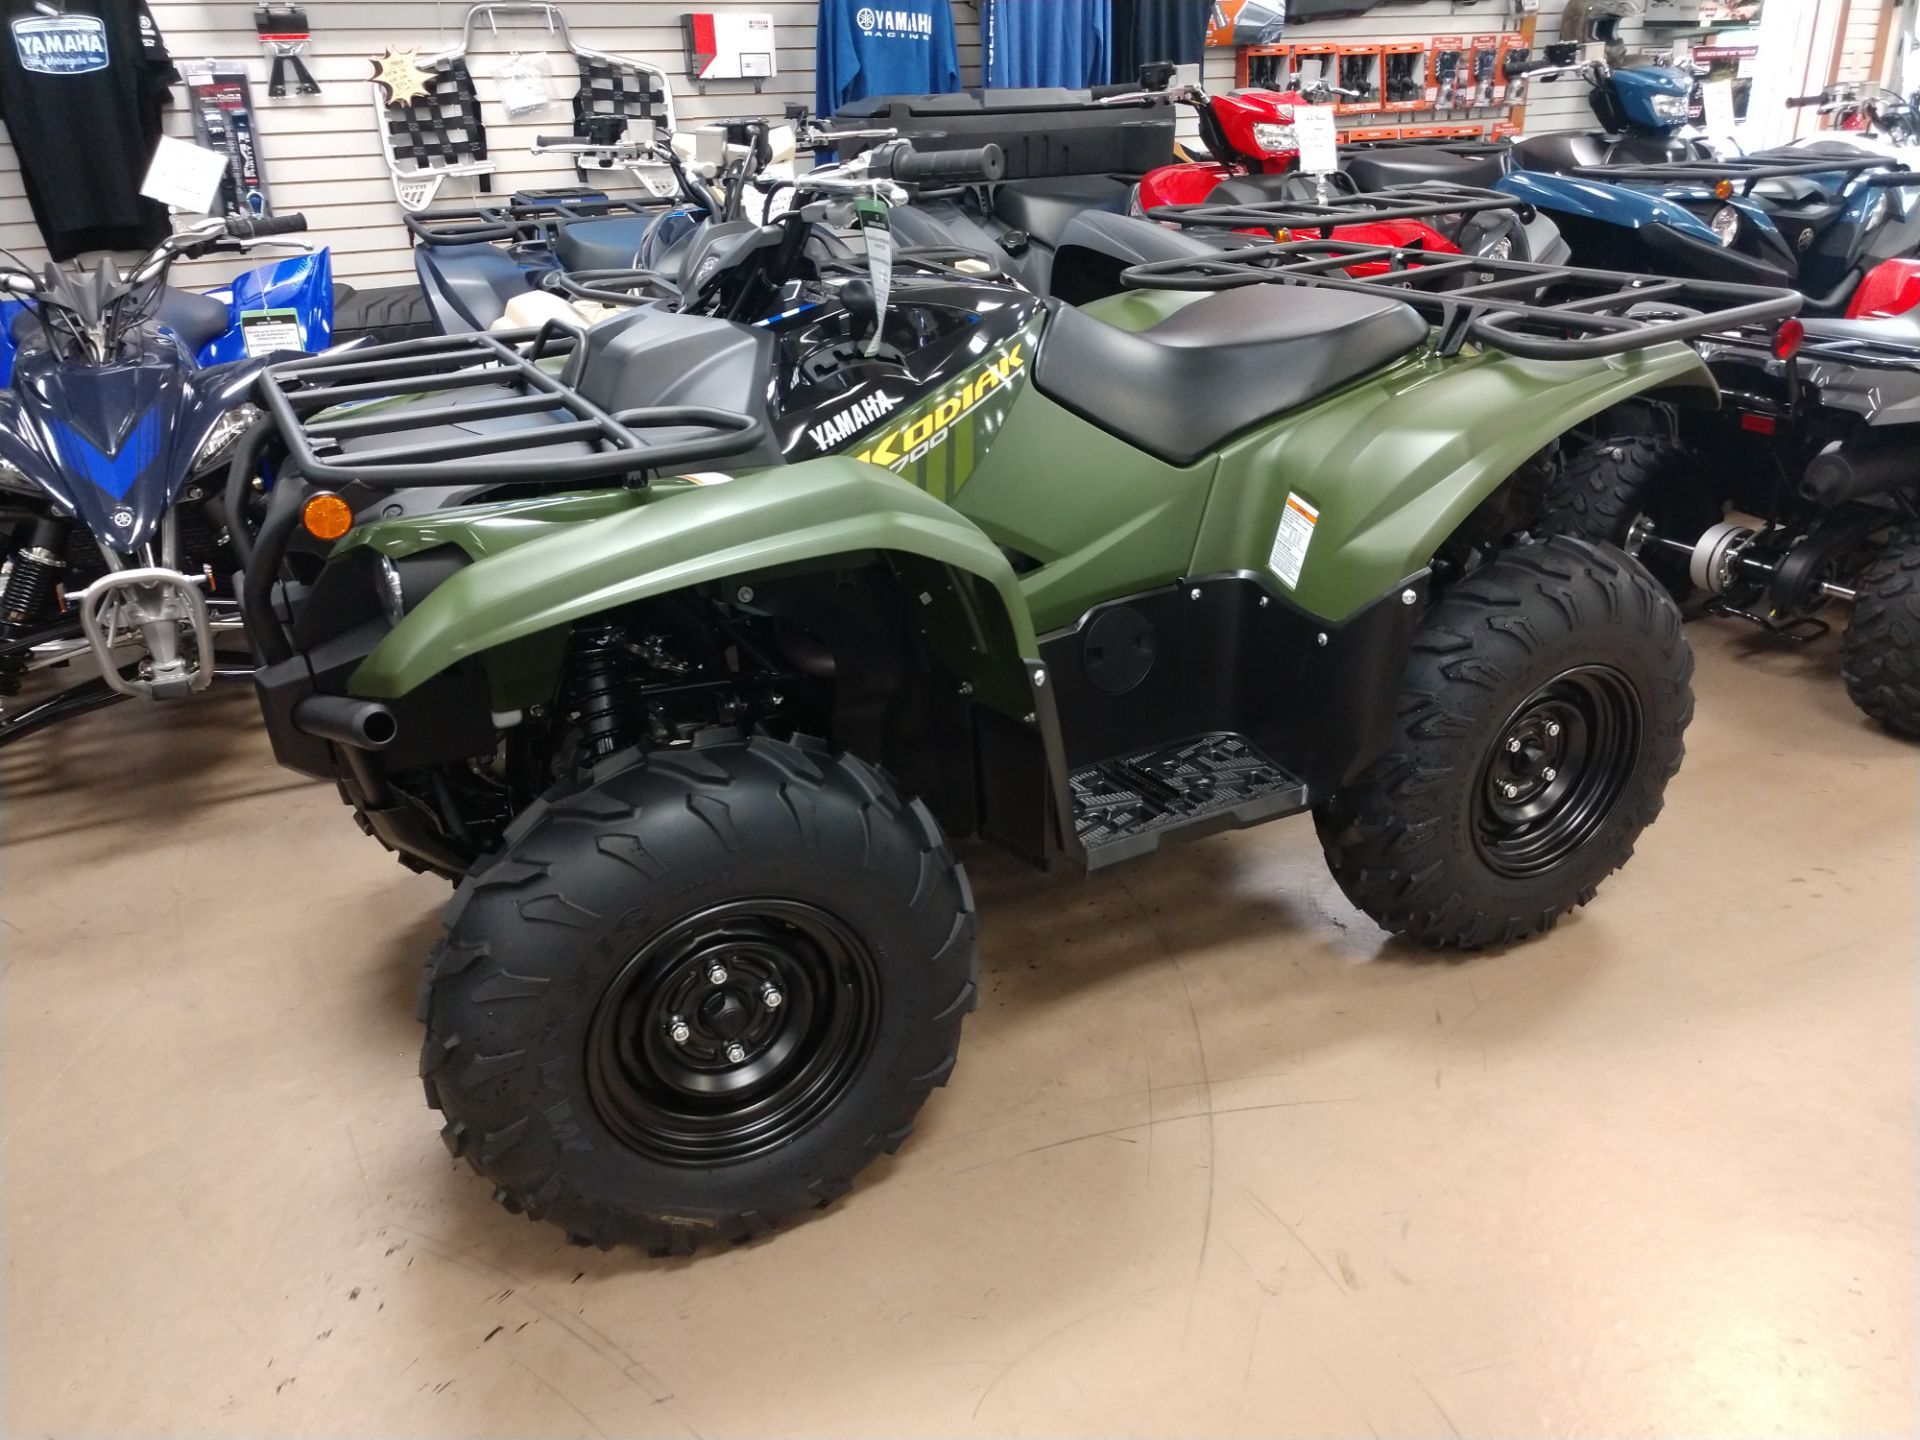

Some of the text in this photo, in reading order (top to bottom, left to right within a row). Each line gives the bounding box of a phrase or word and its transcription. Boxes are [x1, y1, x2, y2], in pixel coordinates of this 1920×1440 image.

[19, 34, 104, 54] YAMAHA
[864, 31, 930, 40] RACING
[808, 389, 896, 451] YAMAHA
[856, 343, 1024, 466] KODIAK
[889, 427, 949, 474] 700
